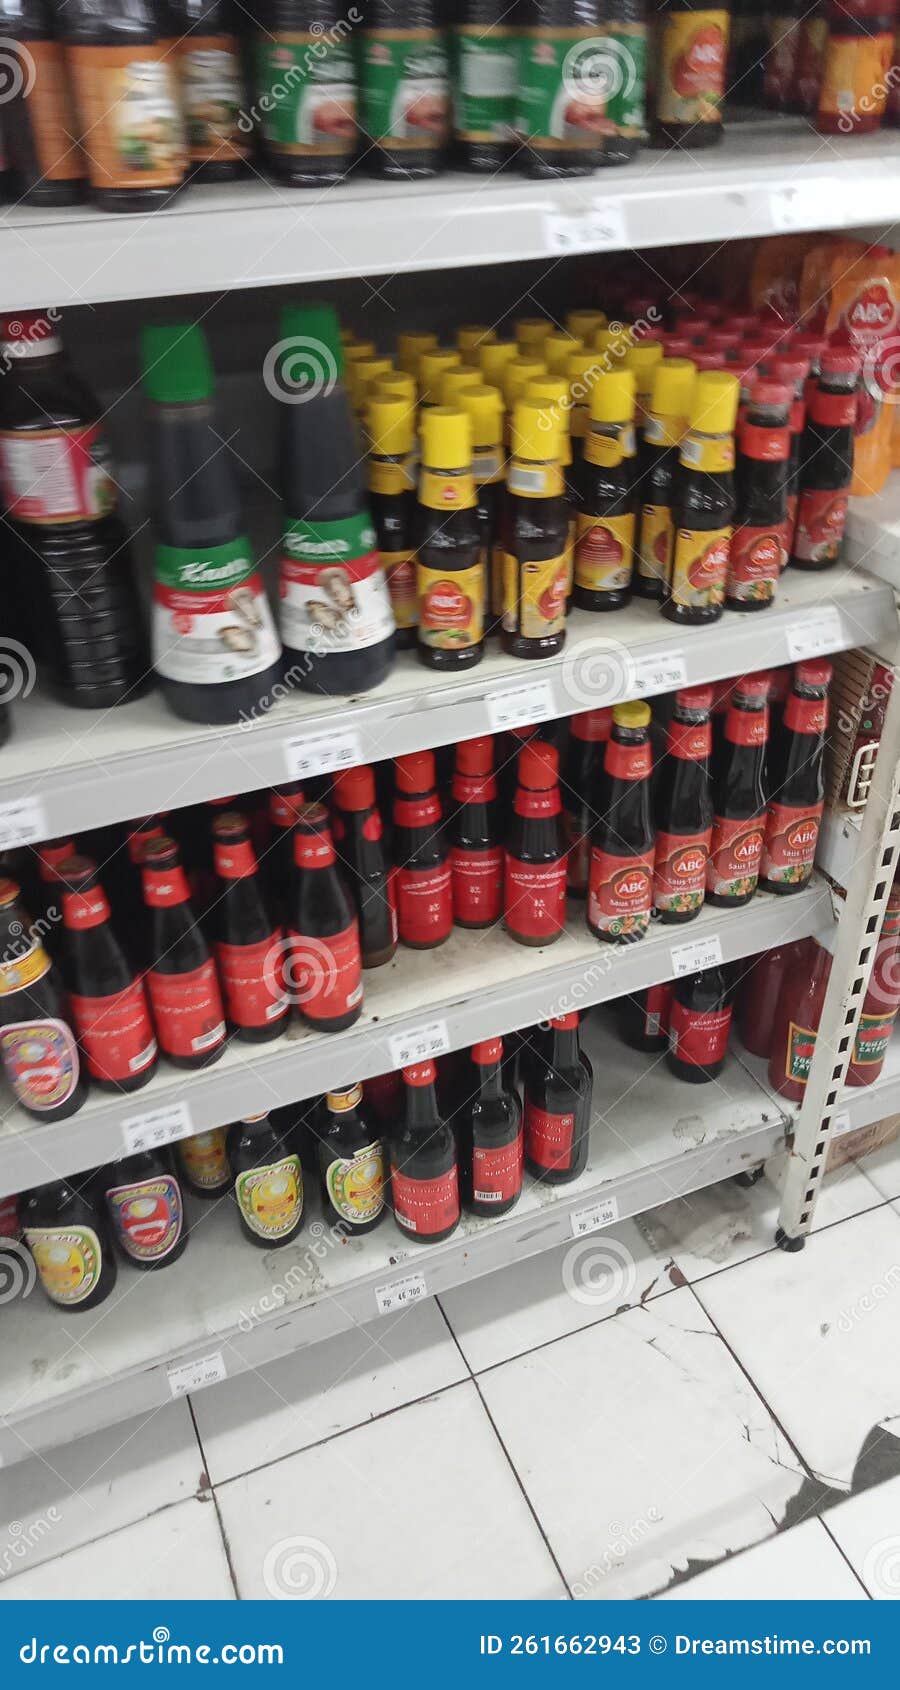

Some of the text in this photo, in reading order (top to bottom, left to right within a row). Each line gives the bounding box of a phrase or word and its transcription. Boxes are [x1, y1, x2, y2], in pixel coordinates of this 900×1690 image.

[850, 302, 891, 324] ABC
[791, 829, 817, 844] ABC
[738, 841, 760, 857] ABC
[677, 858, 704, 872] ABC
[618, 878, 647, 894] ABC
